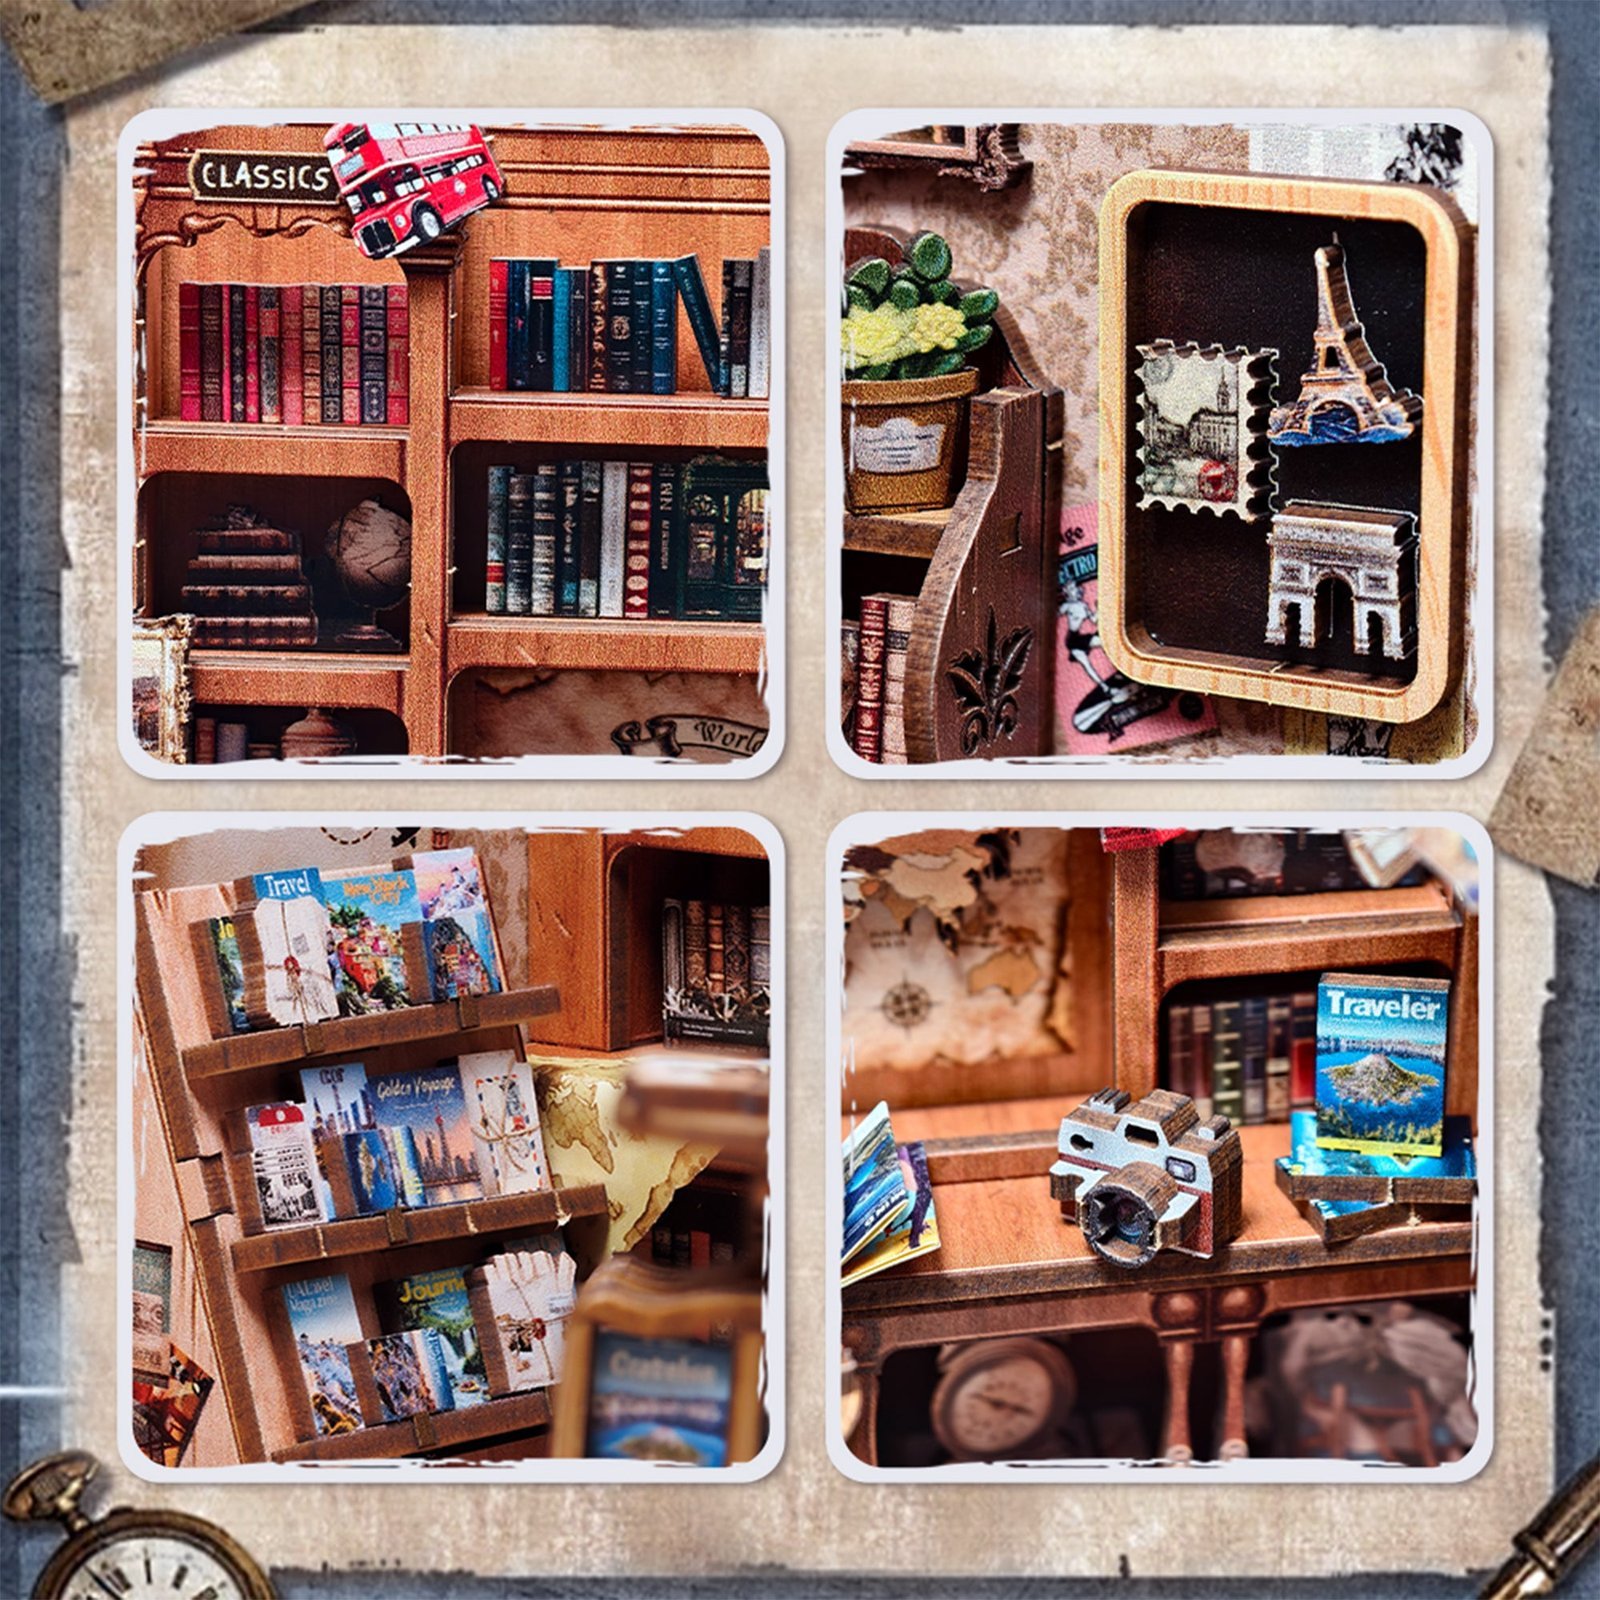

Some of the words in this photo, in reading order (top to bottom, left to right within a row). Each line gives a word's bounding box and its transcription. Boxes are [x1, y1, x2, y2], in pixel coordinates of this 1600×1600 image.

[202, 161, 331, 192] CLASSICS
[263, 870, 312, 898] Travel
[1327, 989, 1441, 1021] Traveler
